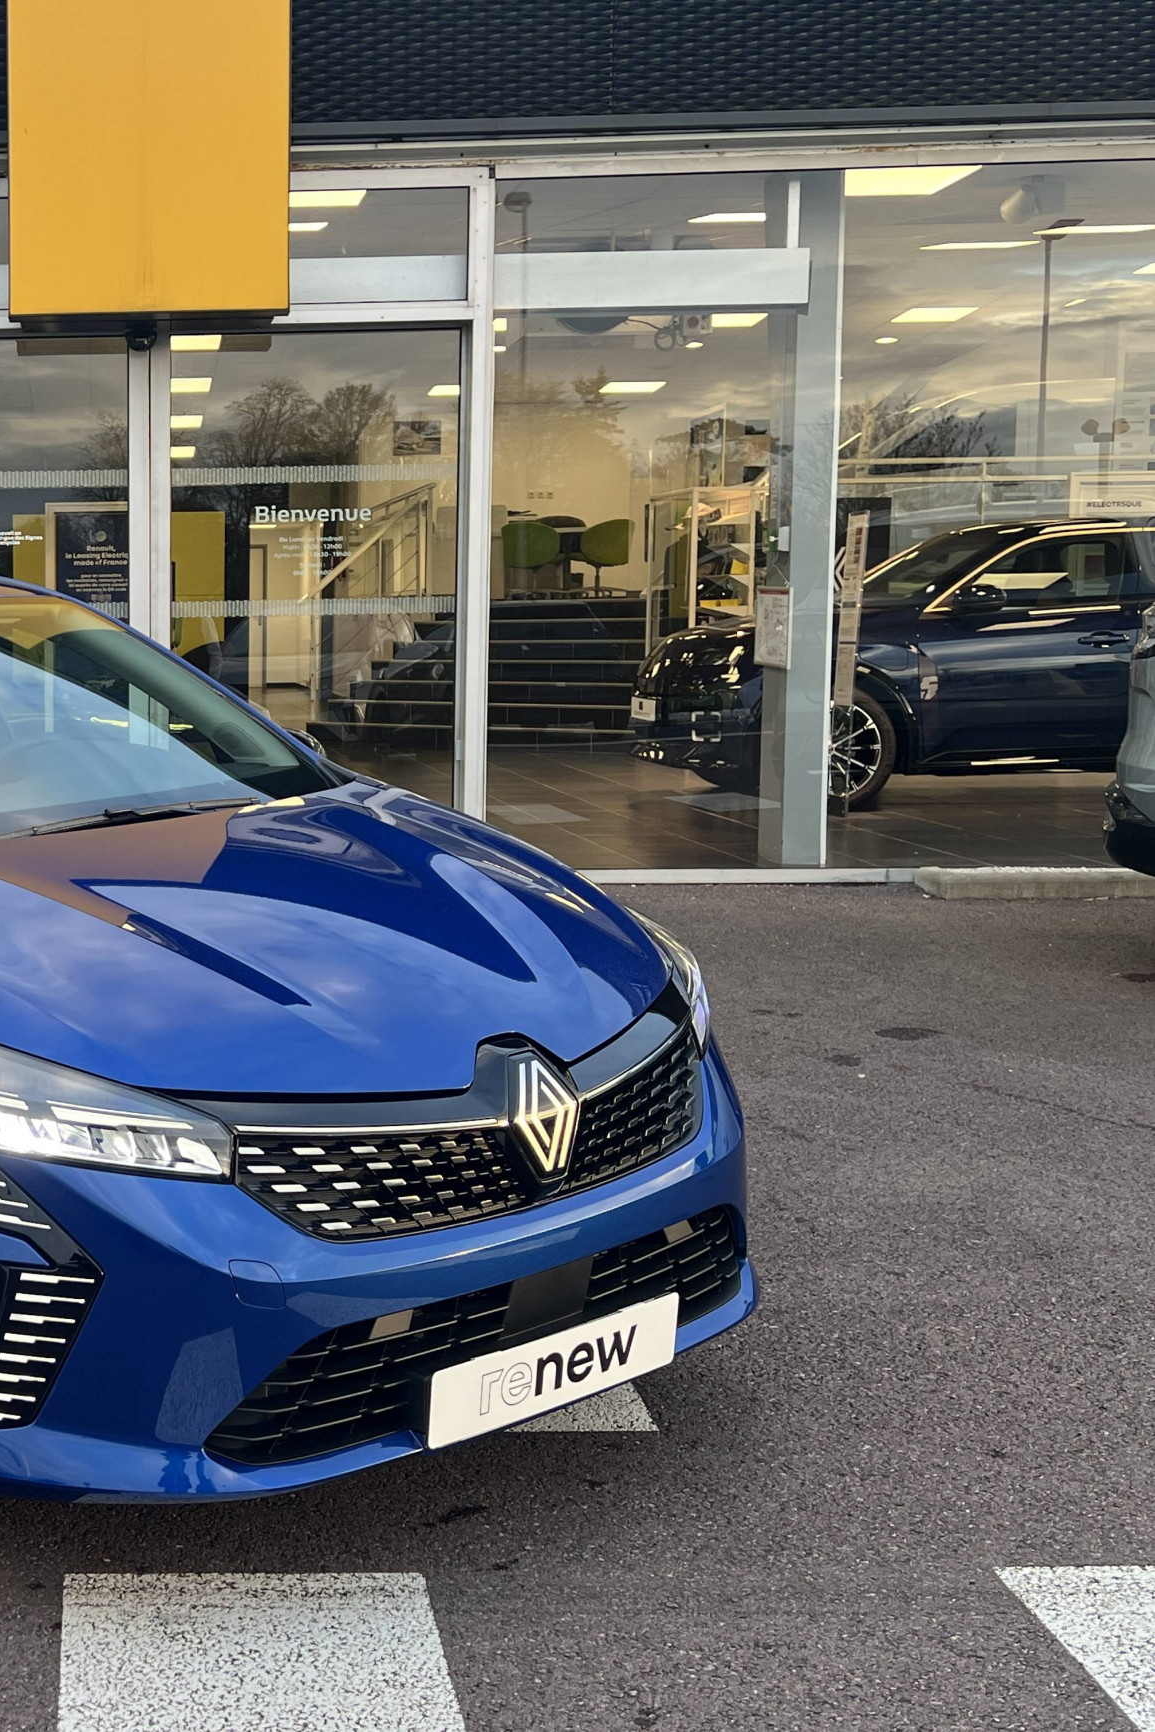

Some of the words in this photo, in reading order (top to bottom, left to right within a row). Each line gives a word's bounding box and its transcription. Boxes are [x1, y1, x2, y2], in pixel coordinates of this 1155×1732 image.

[254, 505, 372, 523] Bienvenue
[73, 552, 101, 560] Leasing
[479, 1323, 637, 1416] renew
